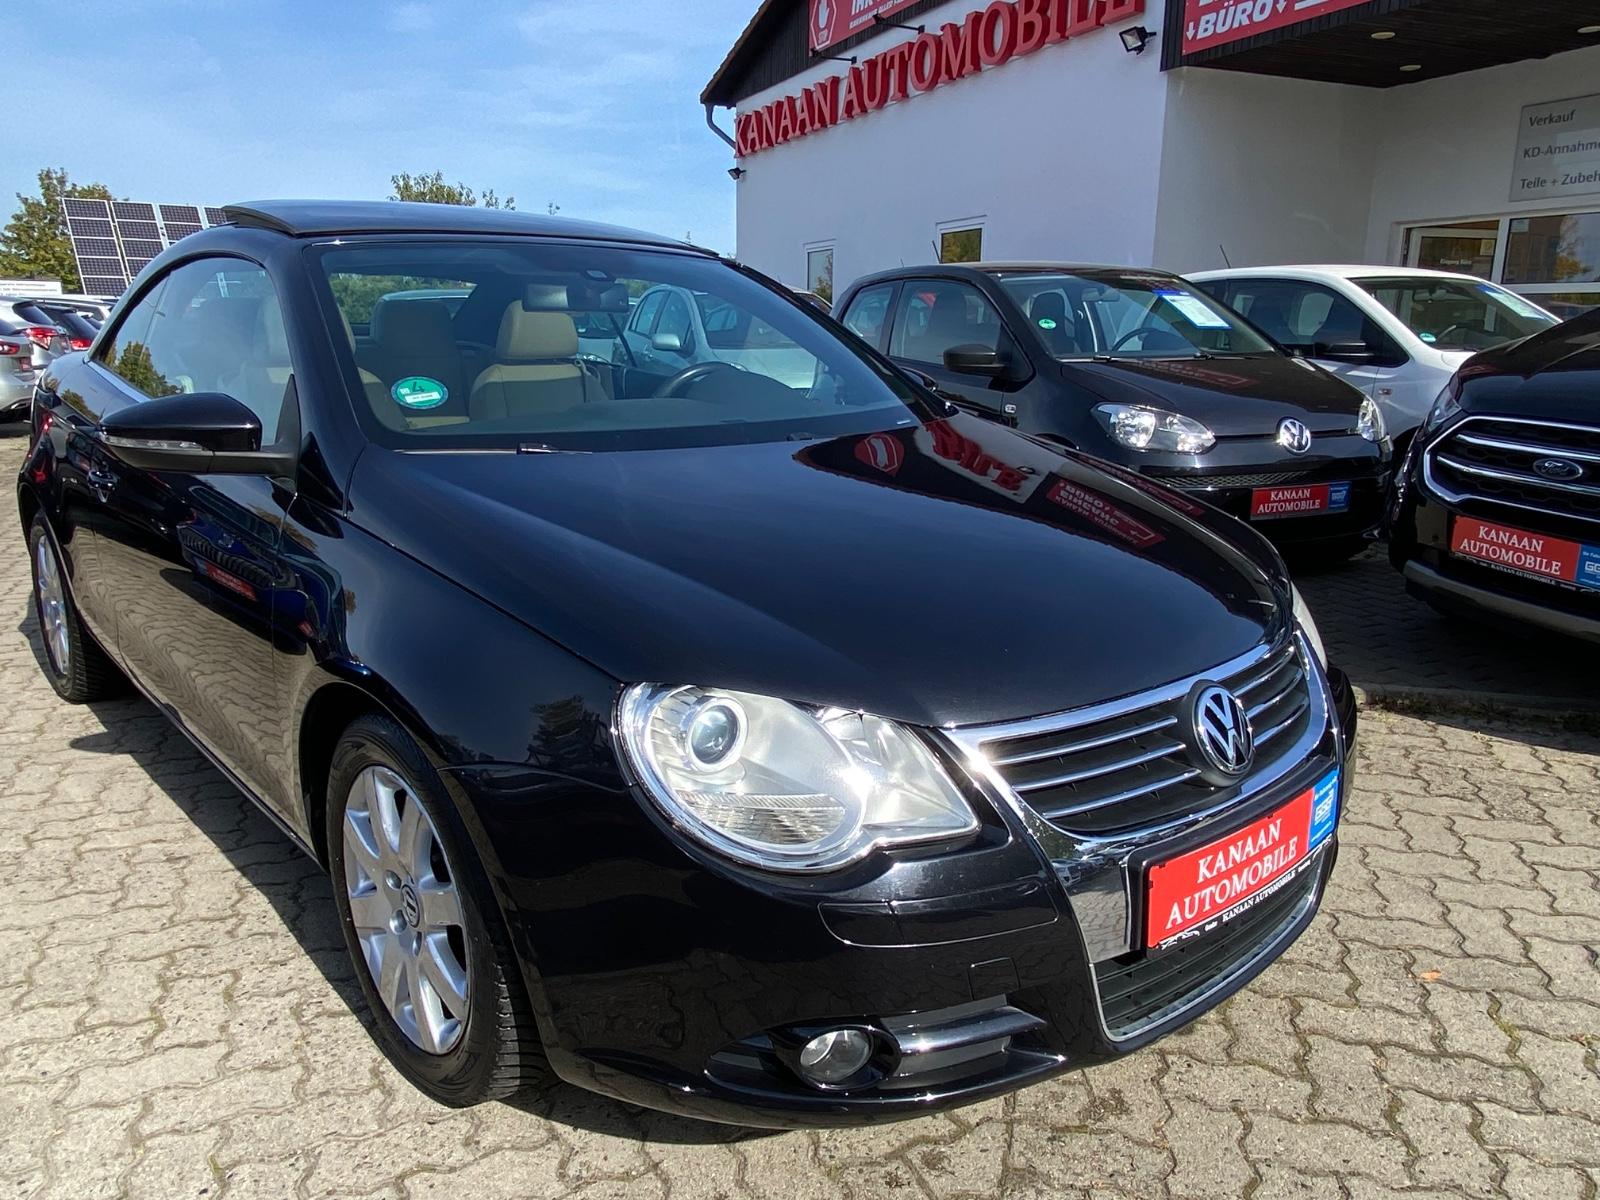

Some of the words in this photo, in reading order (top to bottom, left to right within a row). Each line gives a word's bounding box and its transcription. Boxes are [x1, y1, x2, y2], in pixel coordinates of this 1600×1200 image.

[1196, 0, 1273, 40] BÜRO
[735, 76, 840, 159] KANAAN
[1529, 109, 1576, 127] Verkauf
[1520, 177, 1547, 189] Teile
[1257, 500, 1320, 514] AUTOMOBILE
[1270, 489, 1311, 501] KANAAN
[1460, 538, 1562, 575] AUTOMOBILE
[1479, 526, 1544, 553] KANAAN
[1197, 818, 1282, 884] KANAAN
[1165, 836, 1298, 930] AUTOMOBILE
[1222, 897, 1254, 923] KANAAN
[1255, 870, 1296, 904] AUTOMOBILE
